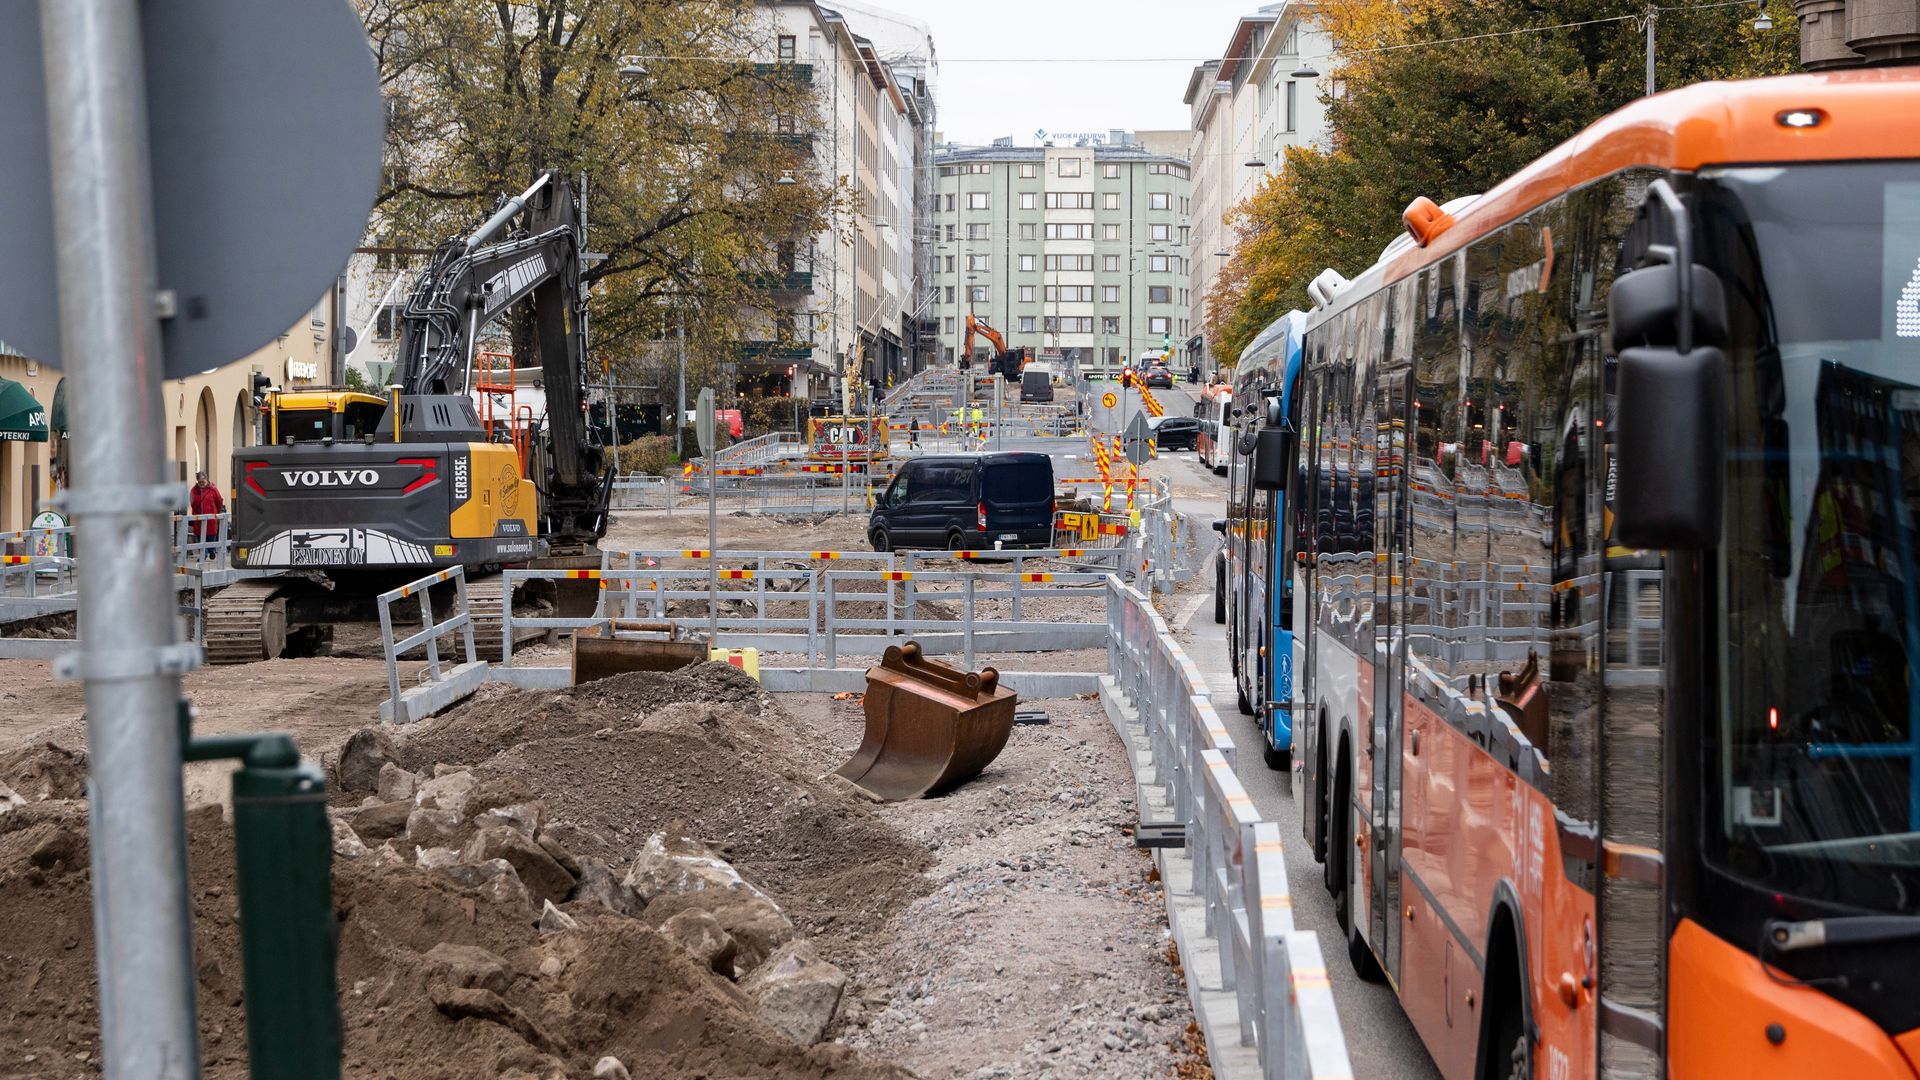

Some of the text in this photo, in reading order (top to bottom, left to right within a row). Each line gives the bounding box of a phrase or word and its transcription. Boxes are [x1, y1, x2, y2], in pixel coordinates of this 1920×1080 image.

[281, 469, 379, 487] VOLVO
[502, 524, 521, 532] VOLVO
[349, 548, 364, 565] OY
